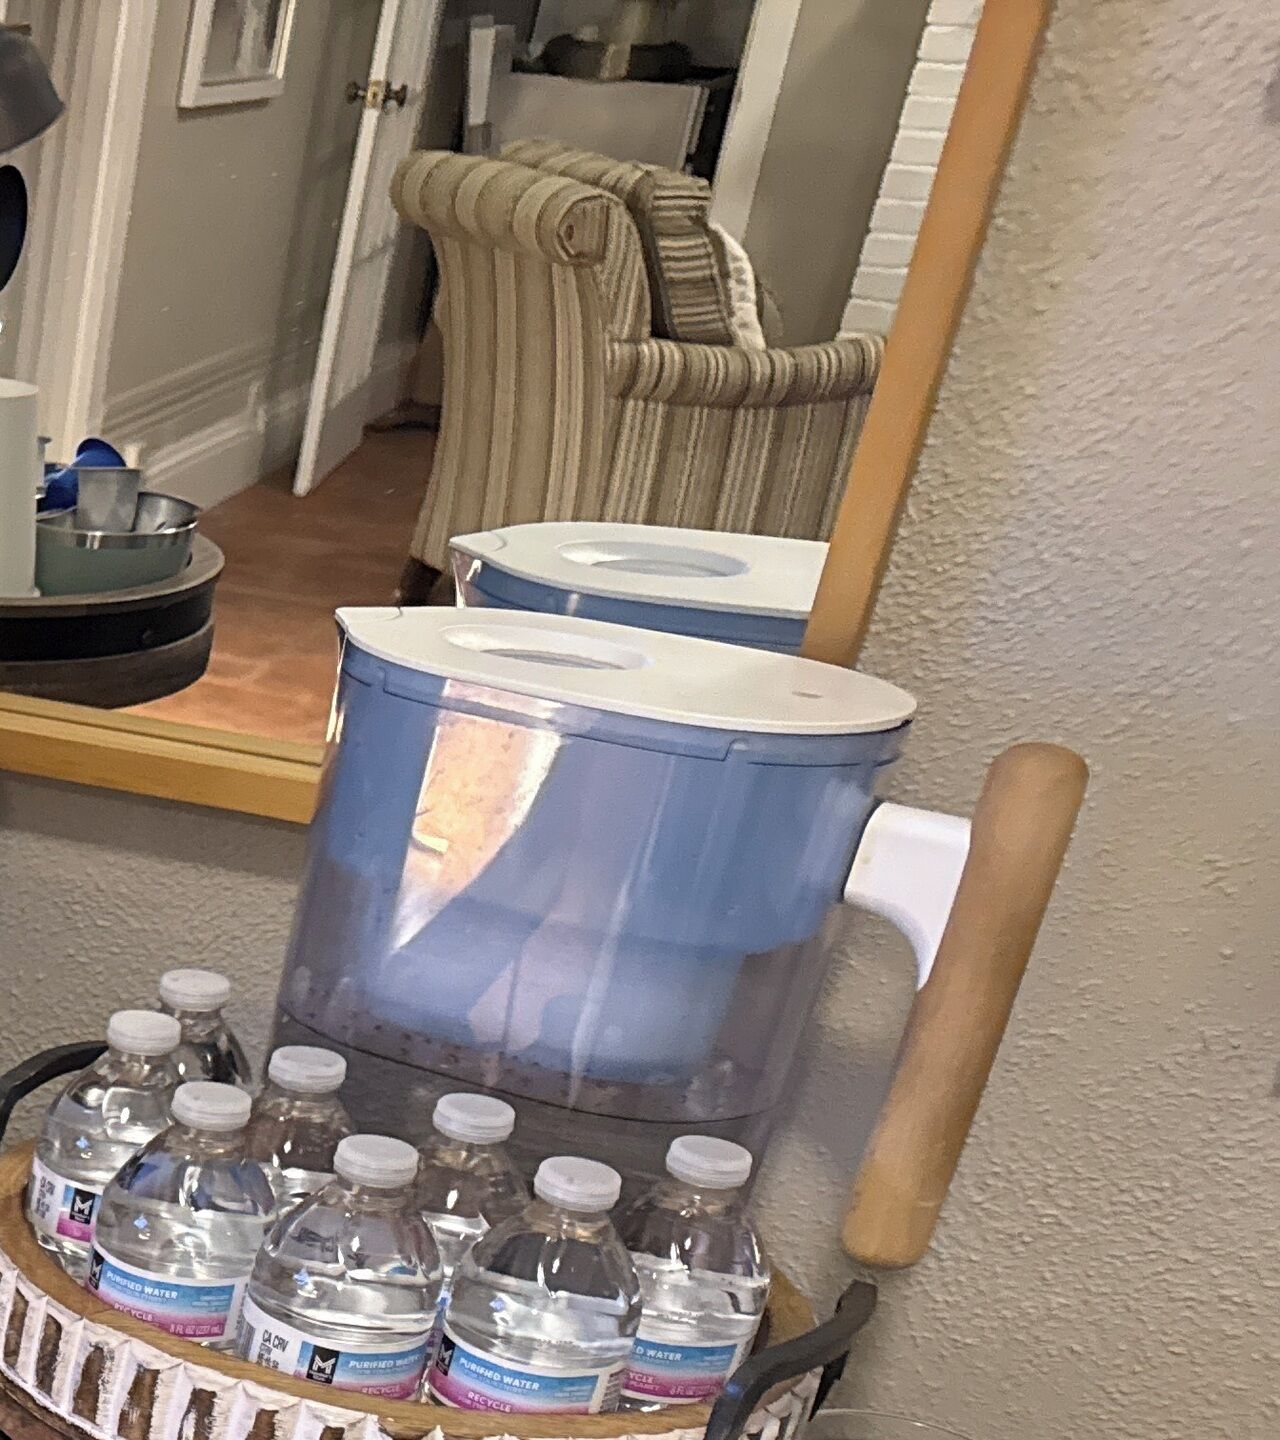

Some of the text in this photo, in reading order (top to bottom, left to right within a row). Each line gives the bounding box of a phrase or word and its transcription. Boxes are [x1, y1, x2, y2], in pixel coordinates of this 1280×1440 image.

[106, 1270, 142, 1292] PURIFIED
[143, 1285, 179, 1300] WATER
[114, 1302, 153, 1322] RECYCLE
[263, 1329, 272, 1345] CA
[646, 1348, 682, 1361] WATER
[348, 1360, 394, 1369] PURIFIED
[460, 1357, 501, 1382] PURIFIED
[502, 1375, 541, 1391] WATER
[628, 1372, 654, 1384] YCLE
[467, 1391, 512, 1413] RECYCLE
